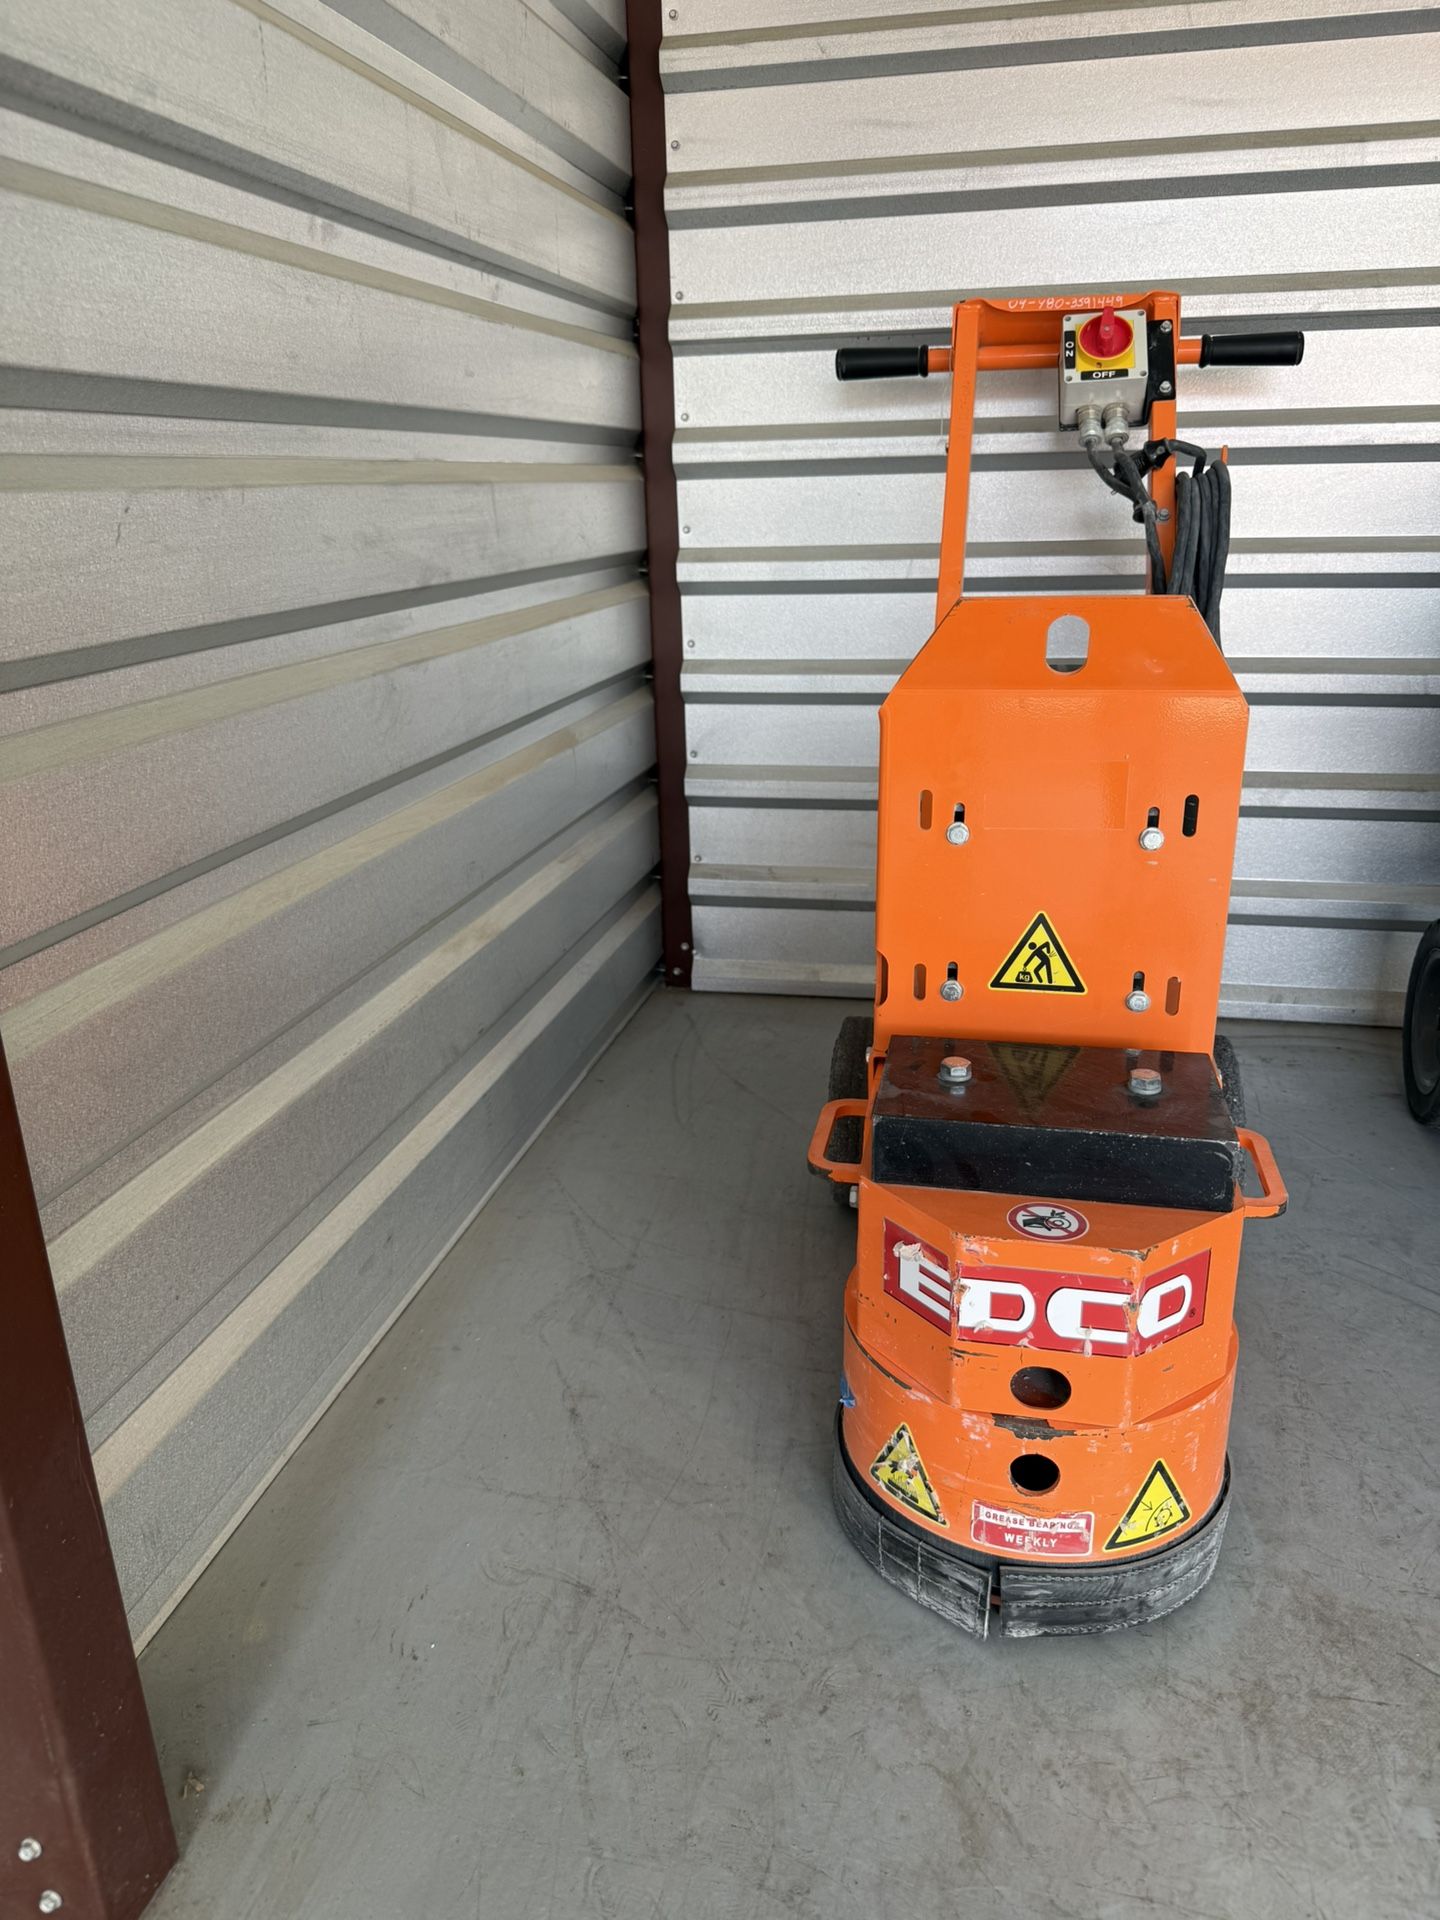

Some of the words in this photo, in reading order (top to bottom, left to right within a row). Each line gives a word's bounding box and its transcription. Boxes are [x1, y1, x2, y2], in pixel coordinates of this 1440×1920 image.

[1065, 341, 1074, 357] ON
[1092, 371, 1116, 379] OFF
[1019, 973, 1031, 982] kg
[899, 1252, 1192, 1344] EDCO
[985, 1511, 1025, 1526] GREASE
[1004, 1532, 1058, 1548] WEEKLY
